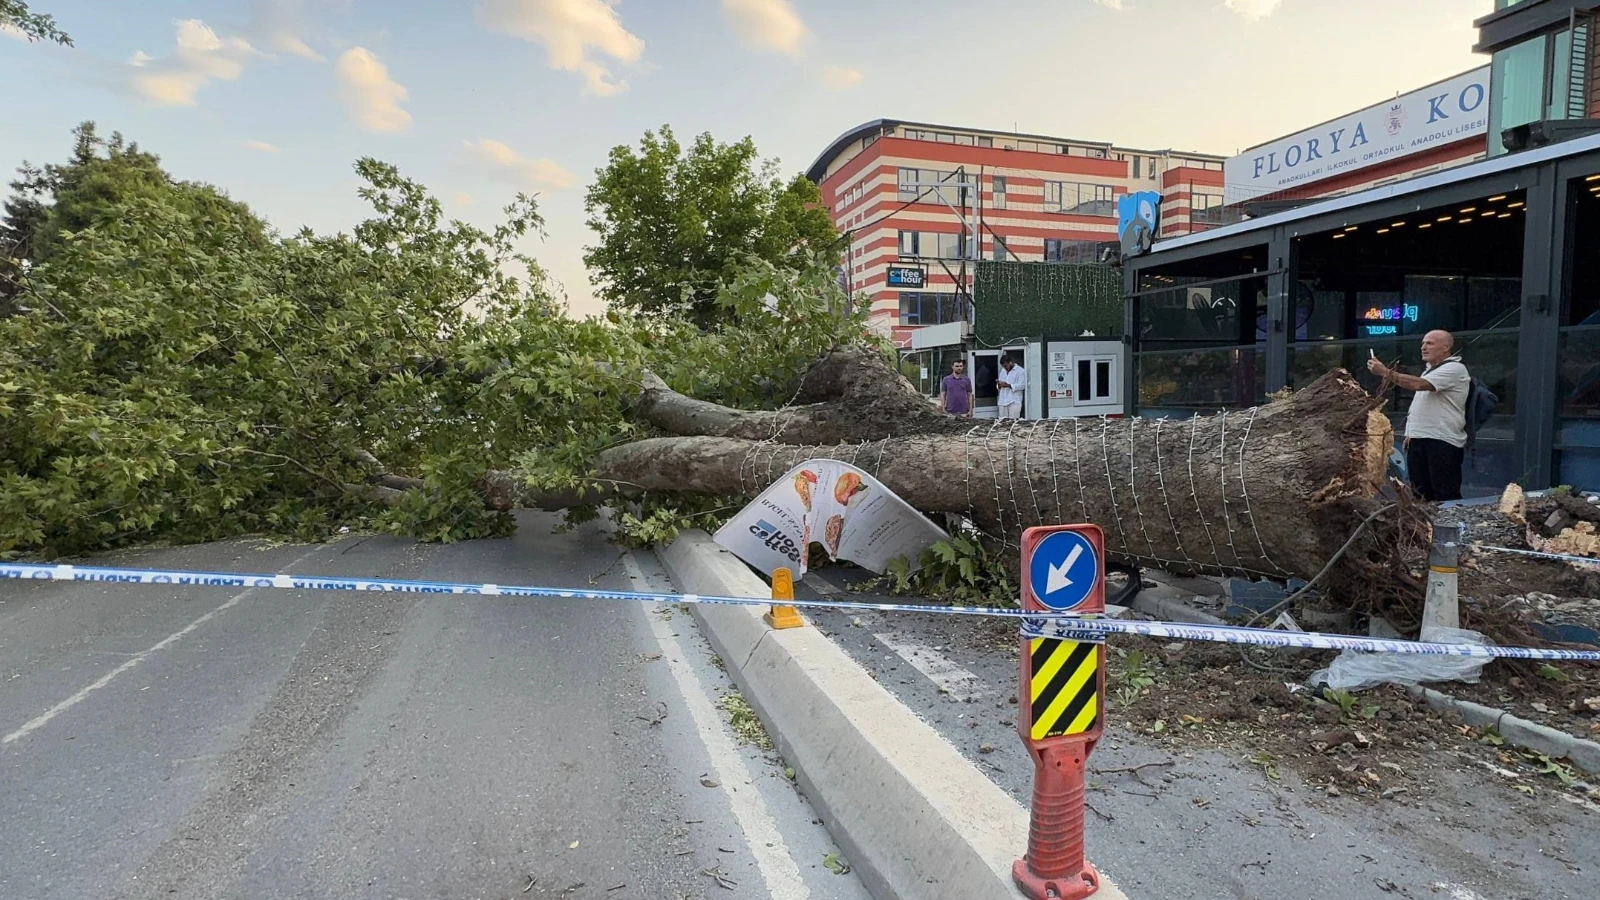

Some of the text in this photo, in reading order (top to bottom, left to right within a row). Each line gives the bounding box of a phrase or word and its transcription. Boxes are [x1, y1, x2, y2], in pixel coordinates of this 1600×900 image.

[1252, 83, 1485, 179] FLORYA KO
[1277, 118, 1487, 186] ANAOKULLARI İLKOKUL ORTAOKUL ANADOLU LİSESİ
